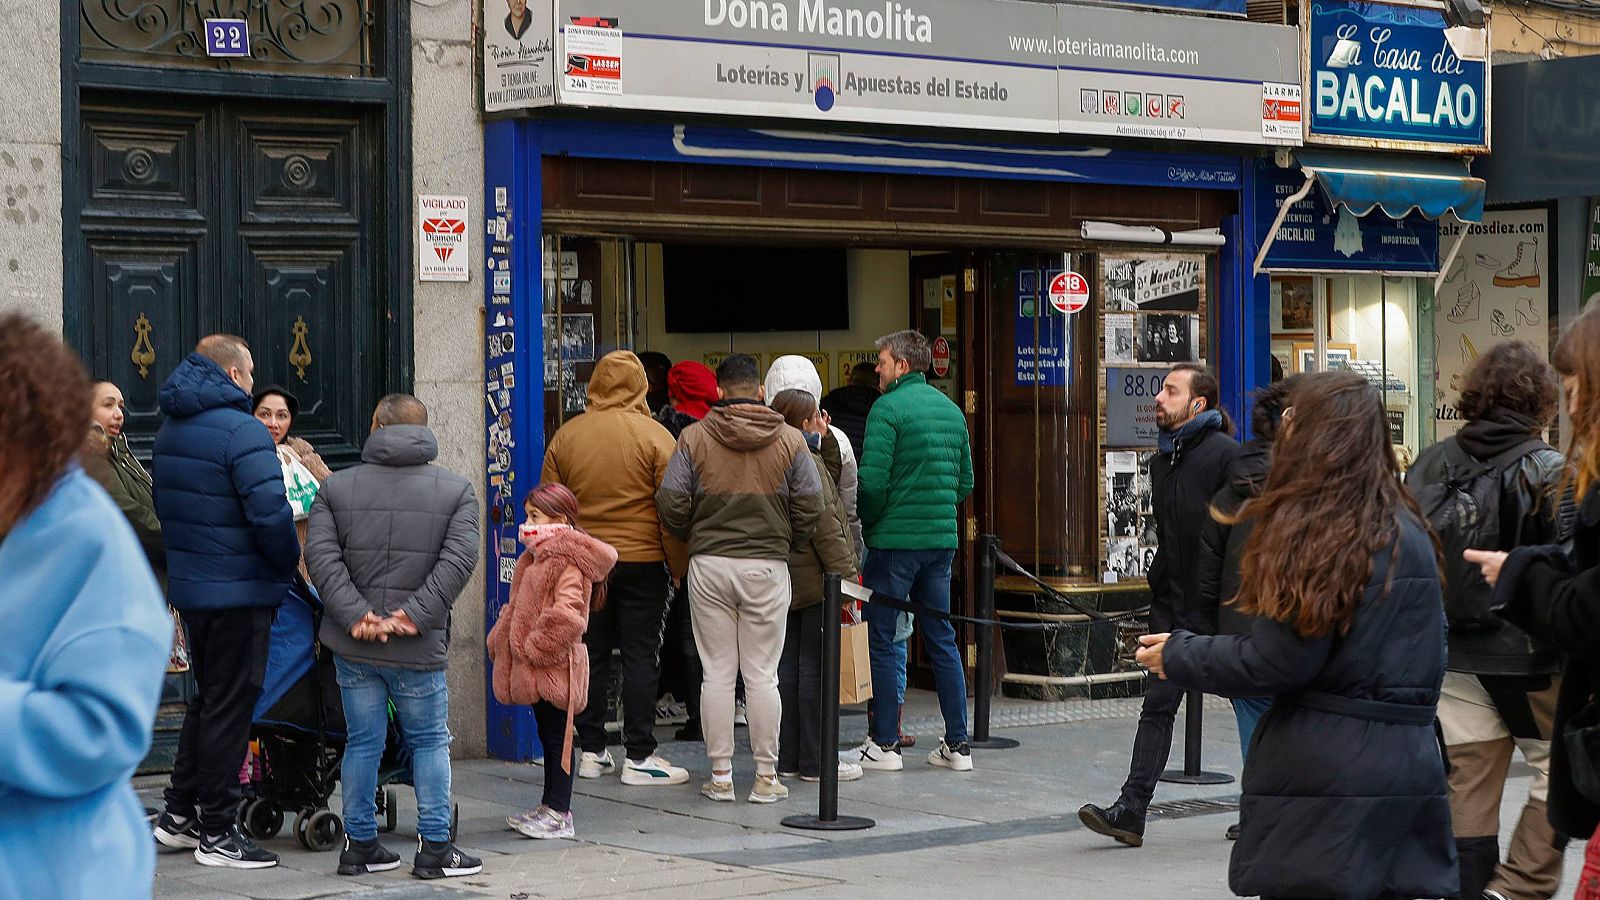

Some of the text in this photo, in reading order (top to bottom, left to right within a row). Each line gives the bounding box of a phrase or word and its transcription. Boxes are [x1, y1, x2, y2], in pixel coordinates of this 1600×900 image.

[798, 0, 932, 43] Manolita
[213, 26, 241, 48] 22
[1008, 36, 1199, 64] www.loteriamanolita.com
[1370, 27, 1422, 70] Casa
[592, 59, 619, 69] LASSER
[571, 79, 587, 89] 24h
[716, 63, 1008, 101] Loterías y Apuestas del Estado
[1264, 86, 1300, 97] ALARMA
[1316, 70, 1477, 129] BACALAO
[1116, 125, 1167, 137] Administración
[1177, 128, 1186, 138] 67
[1265, 124, 1277, 133] 24h
[1275, 184, 1294, 194] ESTA
[422, 199, 465, 209] VIGILADO
[1294, 200, 1314, 209] VENDE
[1396, 220, 1404, 229] DE
[1438, 221, 1544, 236] alzdosdiez.com
[1276, 227, 1315, 242] BACALAO
[1057, 276, 1080, 291] +18
[856, 352, 880, 362] PREM
[1017, 359, 1055, 370] Apustas
[1137, 404, 1143, 413] EL
